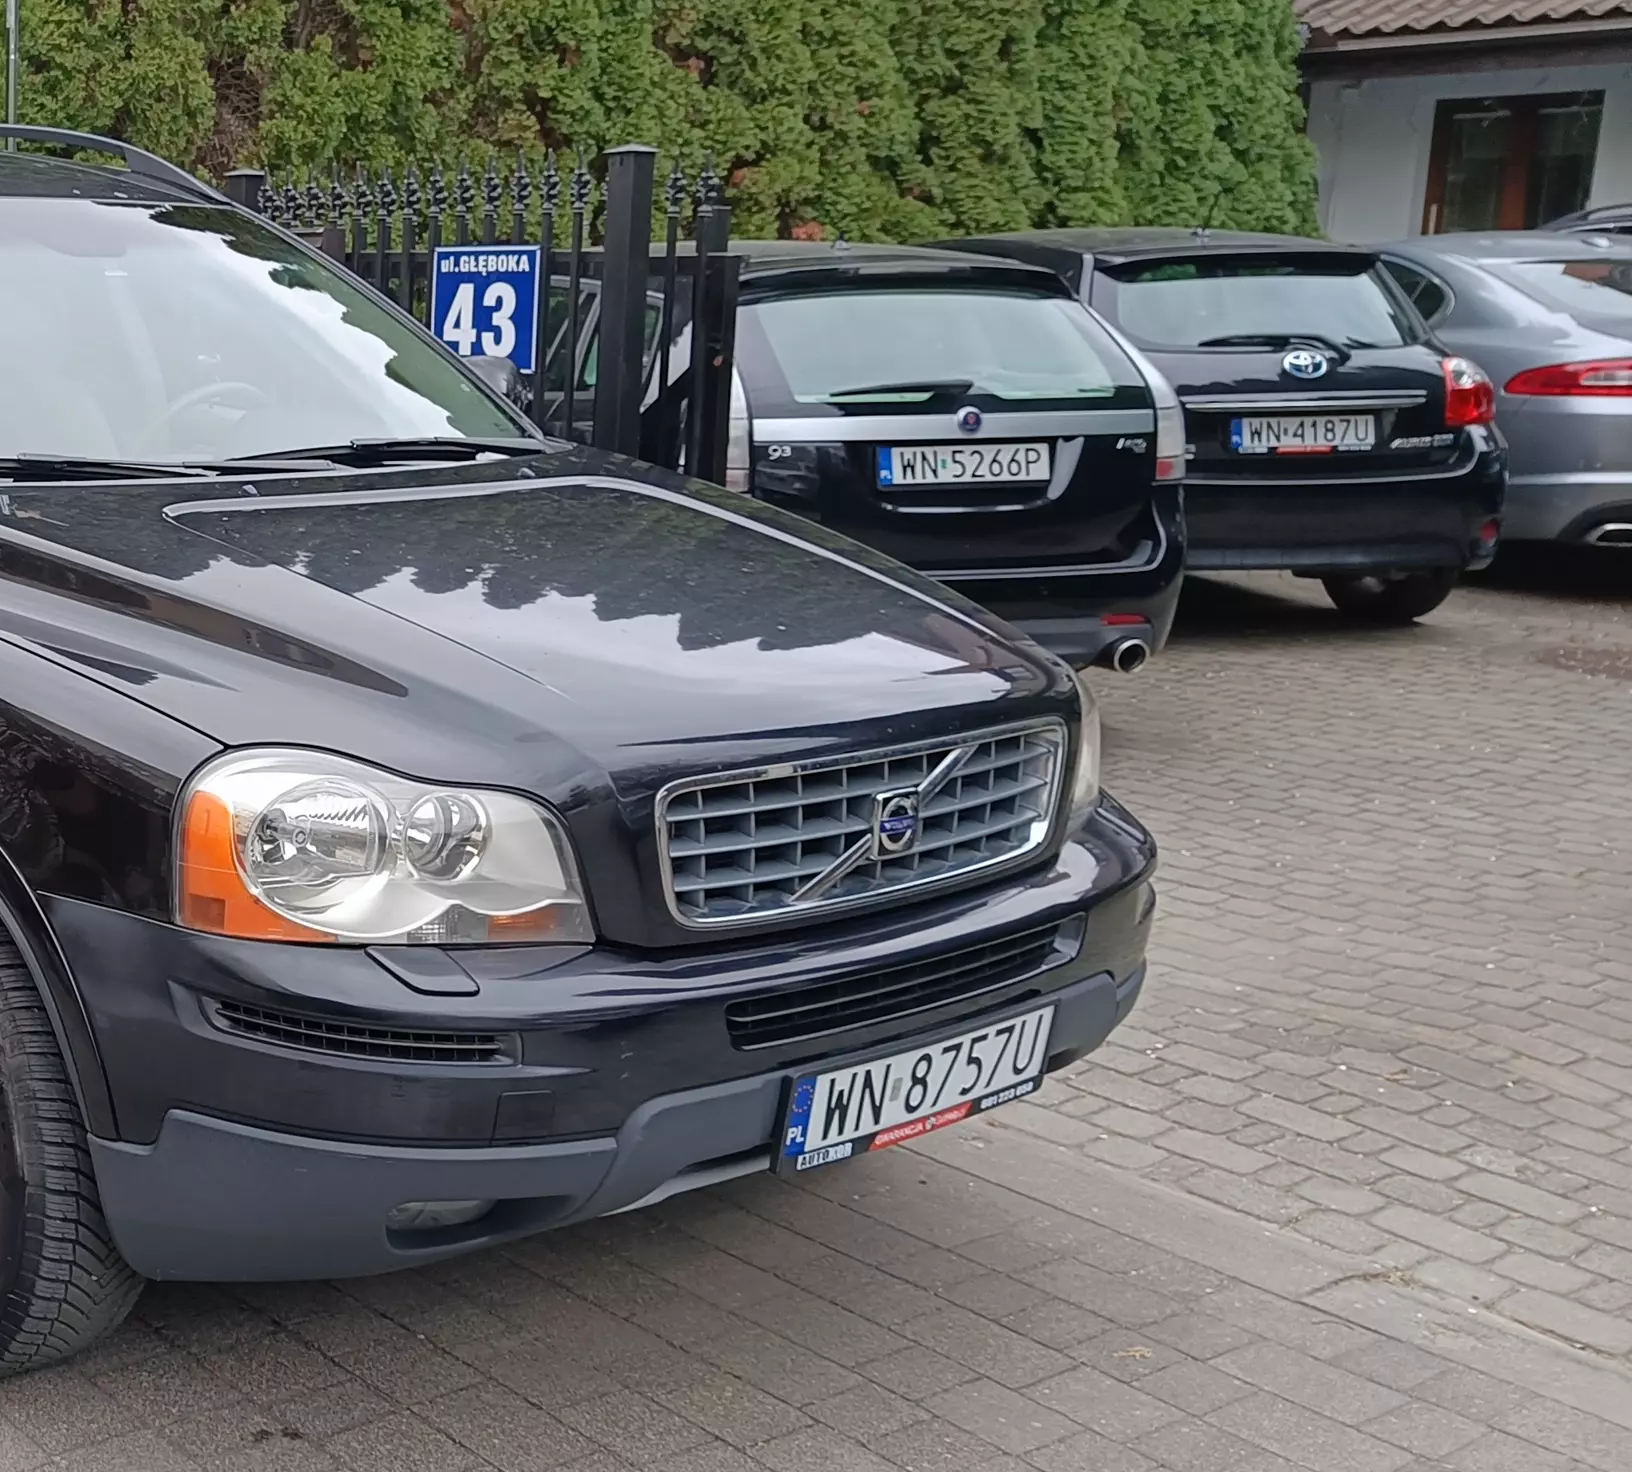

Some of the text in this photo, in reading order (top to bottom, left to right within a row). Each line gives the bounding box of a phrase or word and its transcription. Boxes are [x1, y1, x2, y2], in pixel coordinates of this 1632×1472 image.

[443, 281, 517, 358] 43
[1249, 419, 1369, 443] WN 4187U
[900, 448, 1041, 480] WN 5266P
[821, 1013, 1044, 1141] WN 8757U
[785, 1125, 805, 1146] PL
